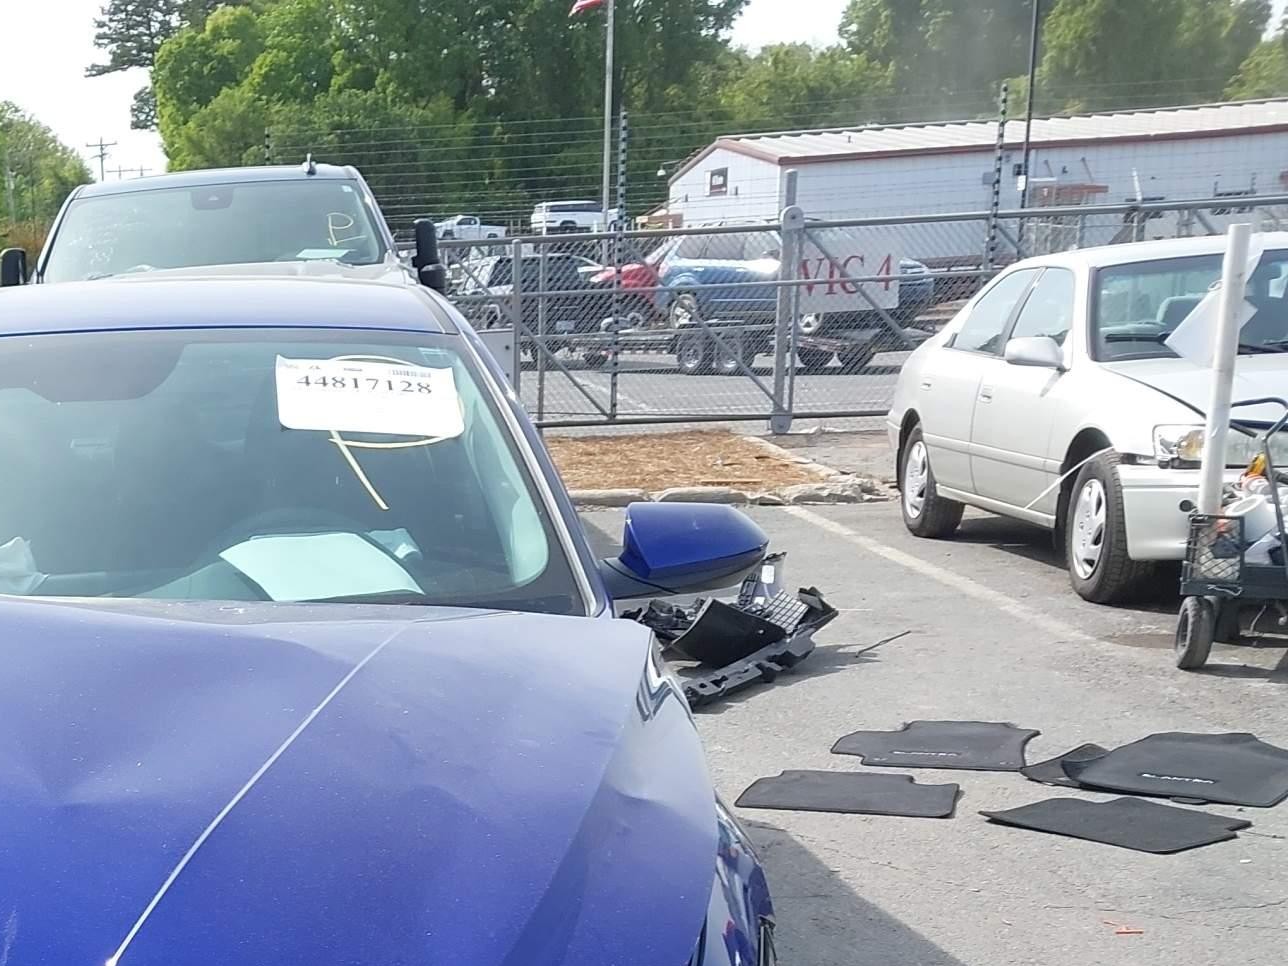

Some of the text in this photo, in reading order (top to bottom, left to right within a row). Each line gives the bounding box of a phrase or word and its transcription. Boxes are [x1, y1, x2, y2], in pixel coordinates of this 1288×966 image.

[800, 253, 893, 297] VIC 4
[296, 374, 433, 395] 44817128
